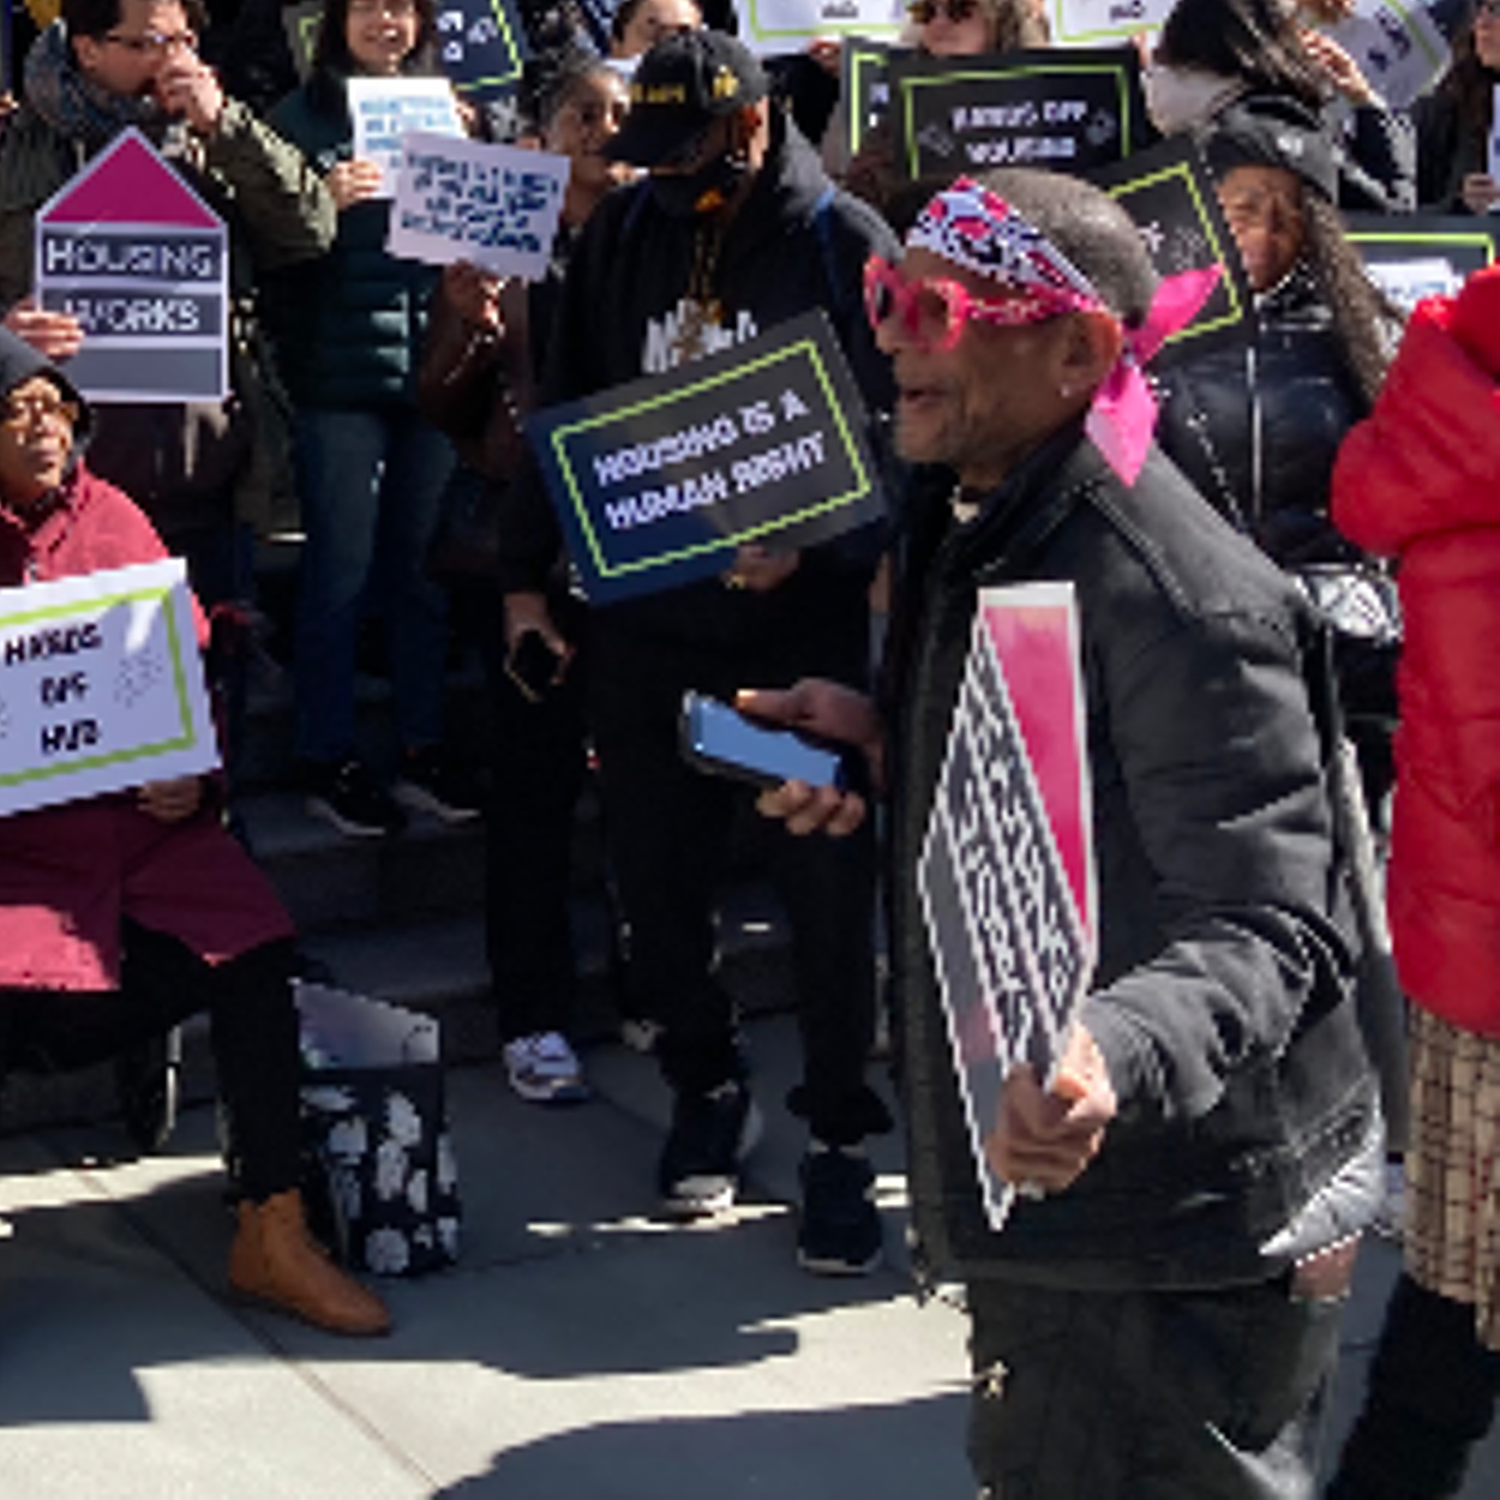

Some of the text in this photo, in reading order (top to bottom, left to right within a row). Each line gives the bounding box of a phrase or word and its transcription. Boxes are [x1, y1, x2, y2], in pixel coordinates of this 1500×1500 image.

[46, 239, 211, 276] HOUSING
[65, 300, 199, 332] WORKS
[593, 388, 810, 486] HOUSING IS A
[605, 431, 823, 530] HUMAN RIGHT
[5, 624, 102, 706] HANDS OFF
[41, 720, 101, 755] HUD
